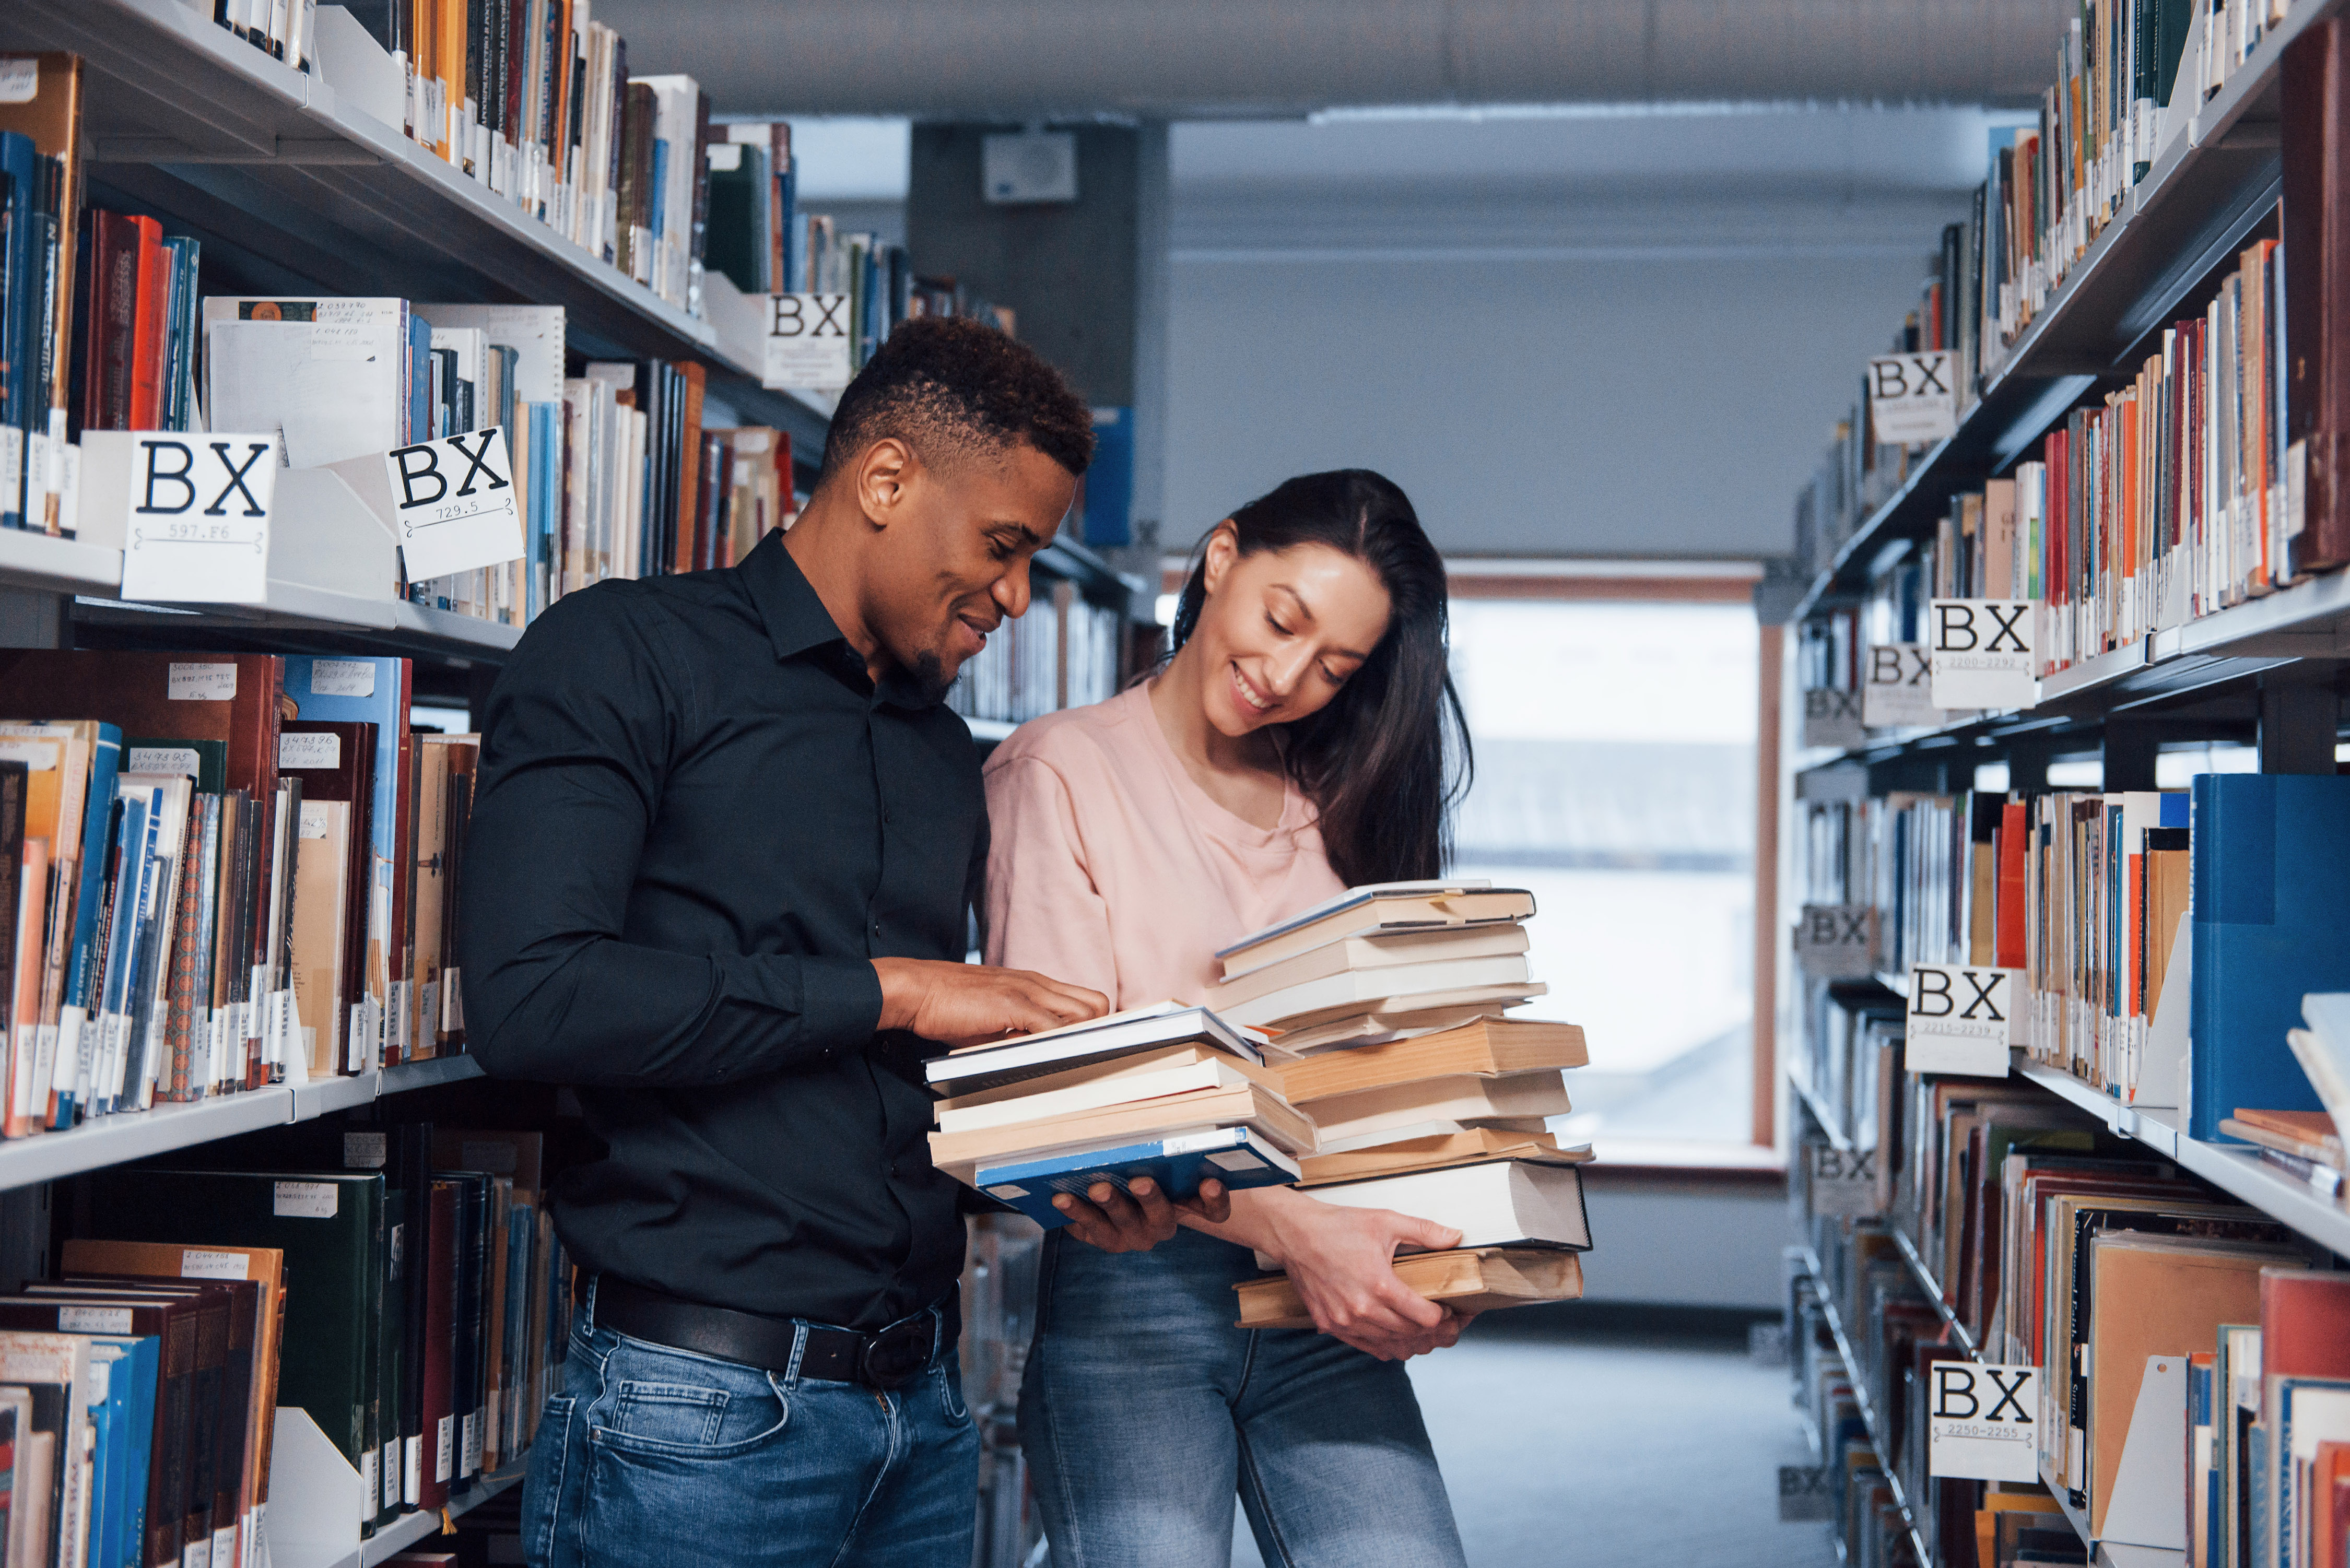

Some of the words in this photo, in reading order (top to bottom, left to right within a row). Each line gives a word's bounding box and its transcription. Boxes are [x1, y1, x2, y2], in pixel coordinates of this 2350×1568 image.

[770, 294, 845, 336] BX
[1871, 355, 1949, 399] BX
[136, 440, 269, 517] BX
[389, 428, 509, 510] BX
[436, 501, 478, 519] 729.5
[169, 524, 230, 539] 597.F6
[1935, 604, 2030, 653] BX
[1871, 645, 1932, 686] BX
[1949, 656, 2016, 668] 2200-2292
[1807, 690, 1860, 718] BX
[1812, 912, 1866, 945] BX
[1911, 968, 2006, 1021] BX
[1924, 1021, 1991, 1036] 2215-2239
[1818, 1145, 1875, 1181] BX
[1934, 1366, 2034, 1423] BX
[1948, 1423, 2018, 1438] 2250-2255
